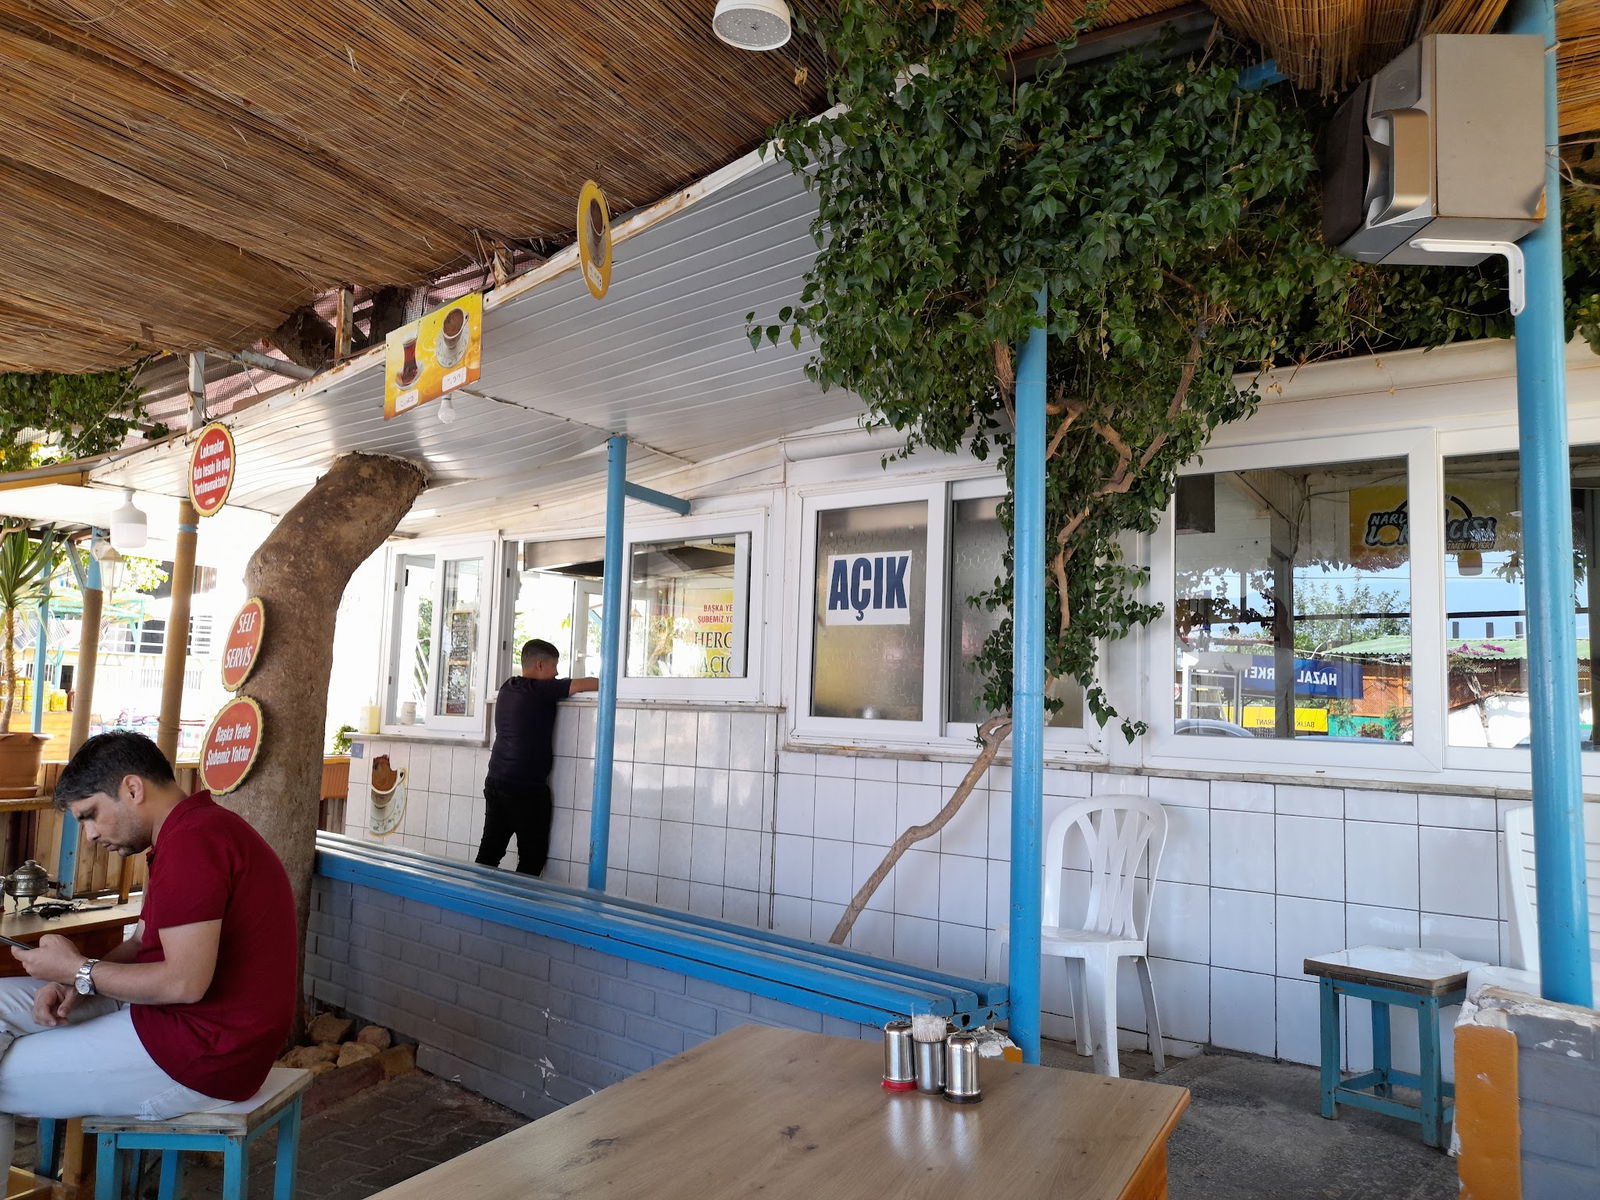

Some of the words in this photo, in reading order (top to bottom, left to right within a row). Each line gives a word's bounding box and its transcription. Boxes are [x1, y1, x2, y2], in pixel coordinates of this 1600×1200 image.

[828, 556, 909, 621] AÇIK
[698, 615, 724, 624] ŞUBEMİZ
[703, 604, 723, 613] BAŞKA
[237, 611, 258, 634] SELF
[225, 642, 253, 669] SERVİS
[215, 726, 234, 745] Başka
[234, 724, 251, 741] Yerde
[206, 746, 230, 770] Şubemiz
[230, 746, 251, 763] Yoktur
